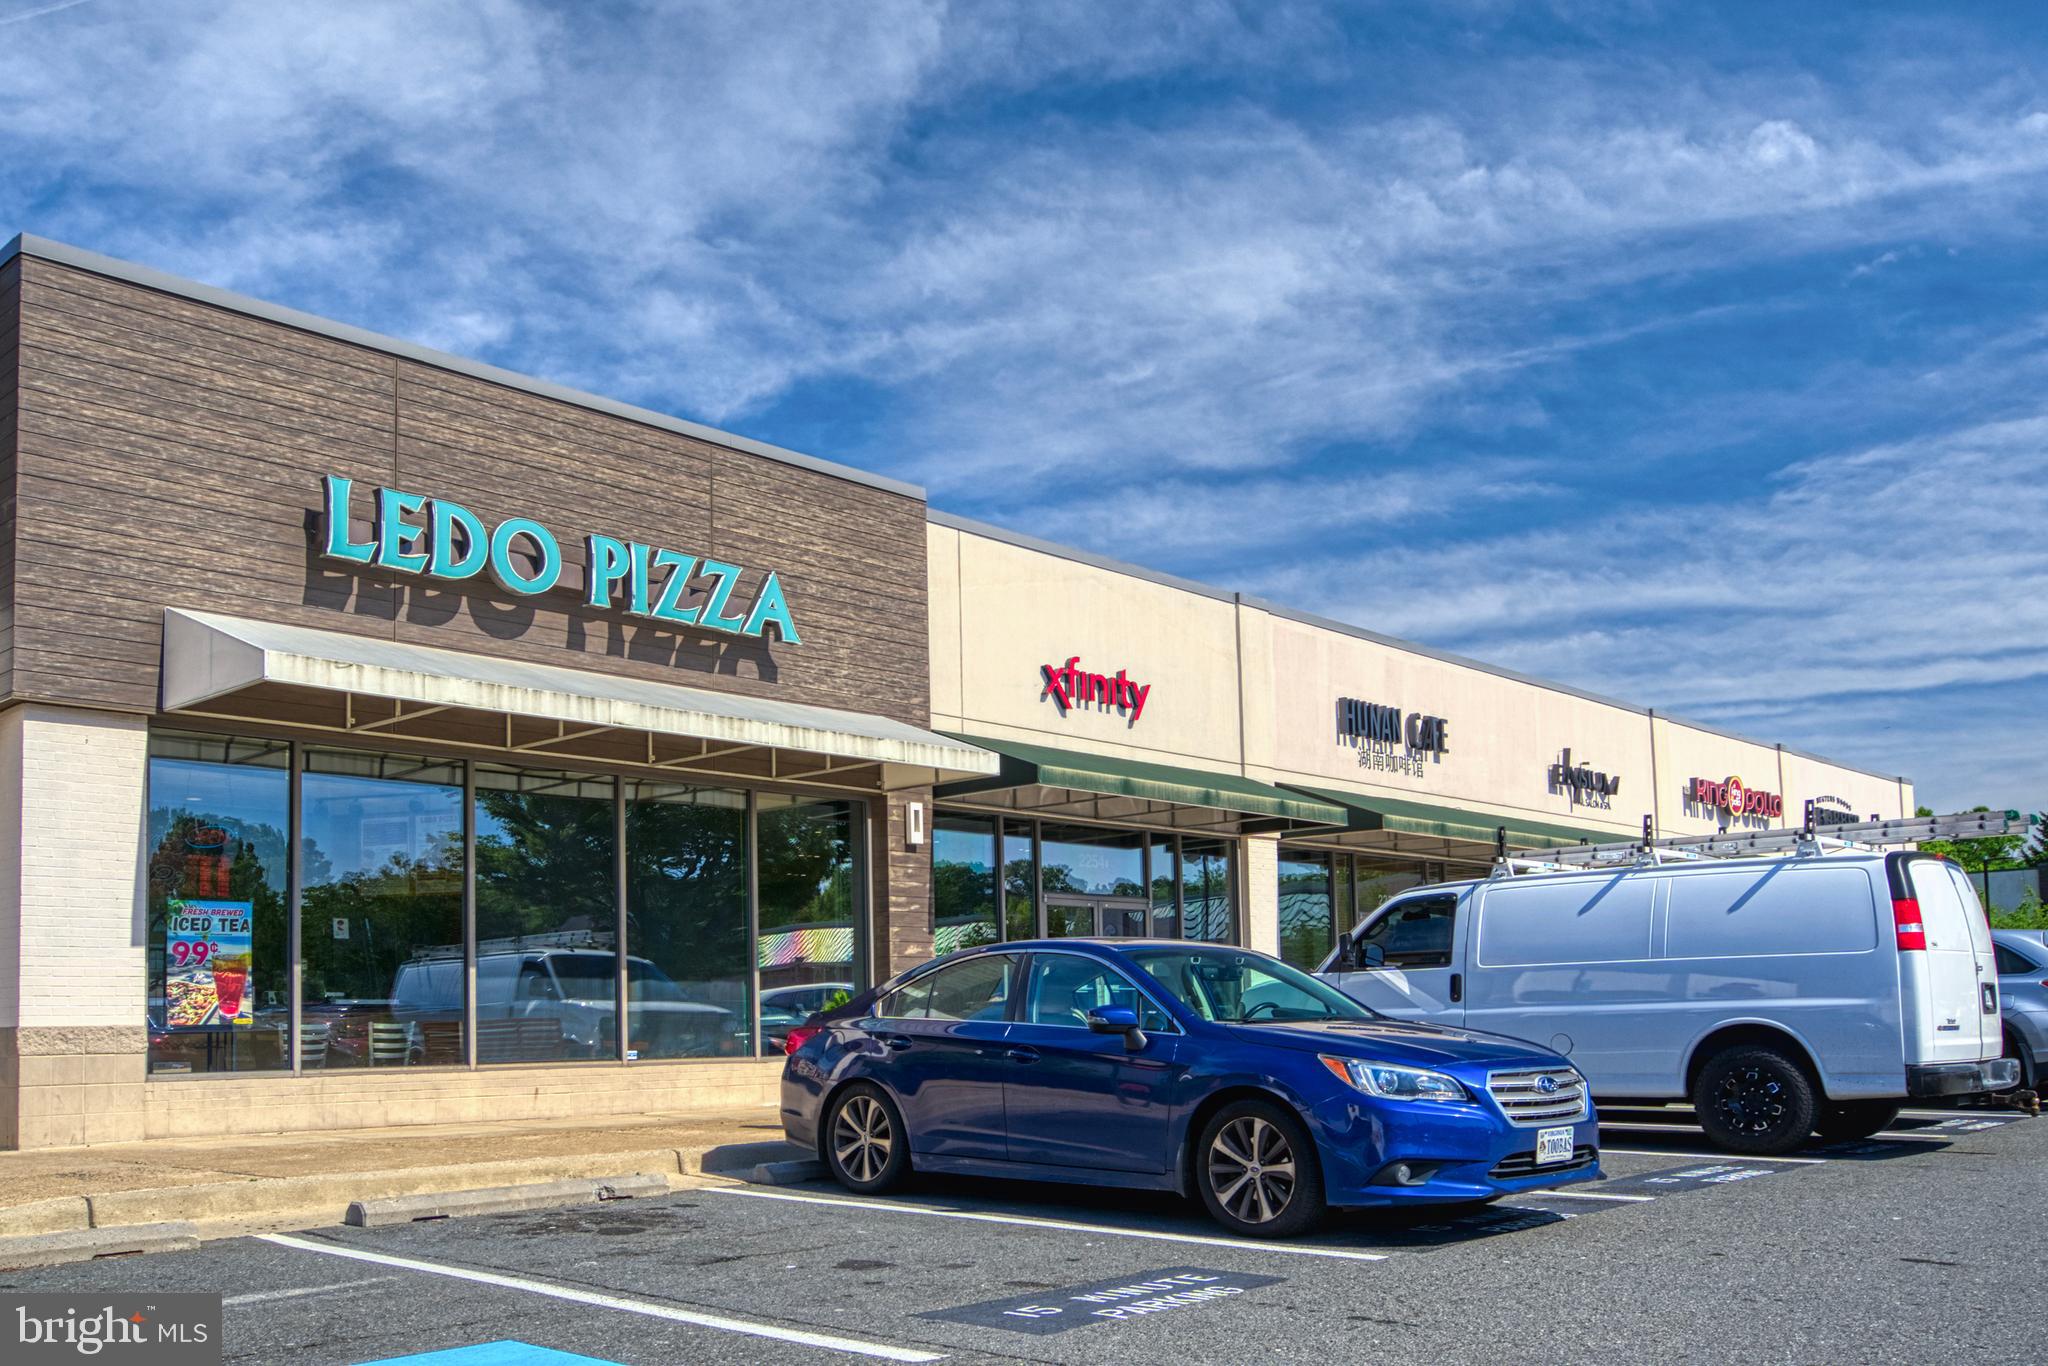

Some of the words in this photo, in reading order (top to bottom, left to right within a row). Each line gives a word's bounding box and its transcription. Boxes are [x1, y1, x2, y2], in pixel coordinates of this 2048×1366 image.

[319, 474, 563, 597] LEDO
[583, 533, 803, 645] PIZZA
[1040, 656, 1151, 721] xfinity
[1337, 696, 1402, 745] HUNAN
[1405, 712, 1450, 754] CAFE
[1358, 746, 1424, 778] 湖南咖啡馆
[172, 917, 212, 932] ICED
[218, 918, 251, 932] TEA
[182, 908, 209, 916] FRESH
[210, 908, 244, 917] BREWED
[1003, 1305, 1064, 1319] 15
[1070, 1273, 1221, 1304] MINUTE
[1091, 1285, 1245, 1321] PARKING
